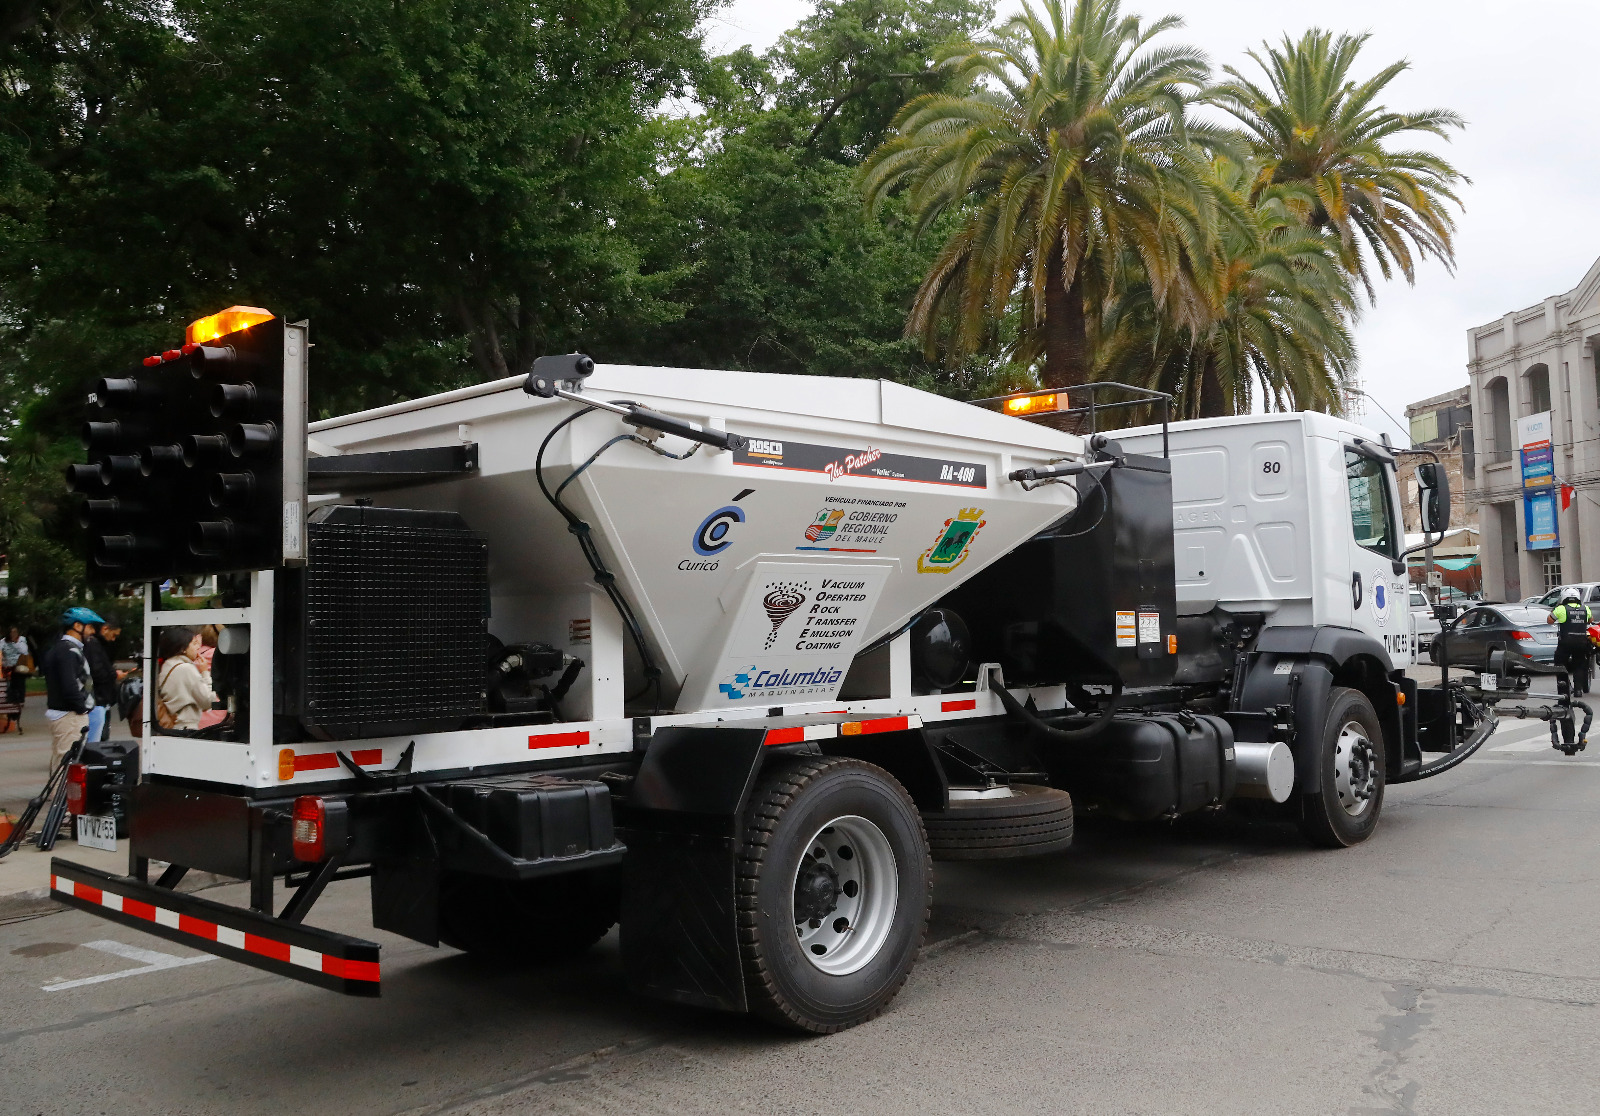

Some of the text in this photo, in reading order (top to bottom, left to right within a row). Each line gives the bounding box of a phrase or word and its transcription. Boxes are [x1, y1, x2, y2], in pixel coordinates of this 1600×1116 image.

[748, 439, 783, 455] ROSCO
[825, 446, 881, 482] The Patcher
[1263, 461, 1281, 474] 80
[940, 464, 976, 482] RA-400
[856, 499, 894, 508] FINANCIADO
[848, 511, 898, 523] GOBIERNO
[840, 523, 890, 535] REGIONAL
[835, 534, 885, 544] DEL MAULE
[678, 560, 720, 571] Curicó
[752, 666, 843, 688] Columbia
[748, 686, 835, 698] MAQUINARIAS
